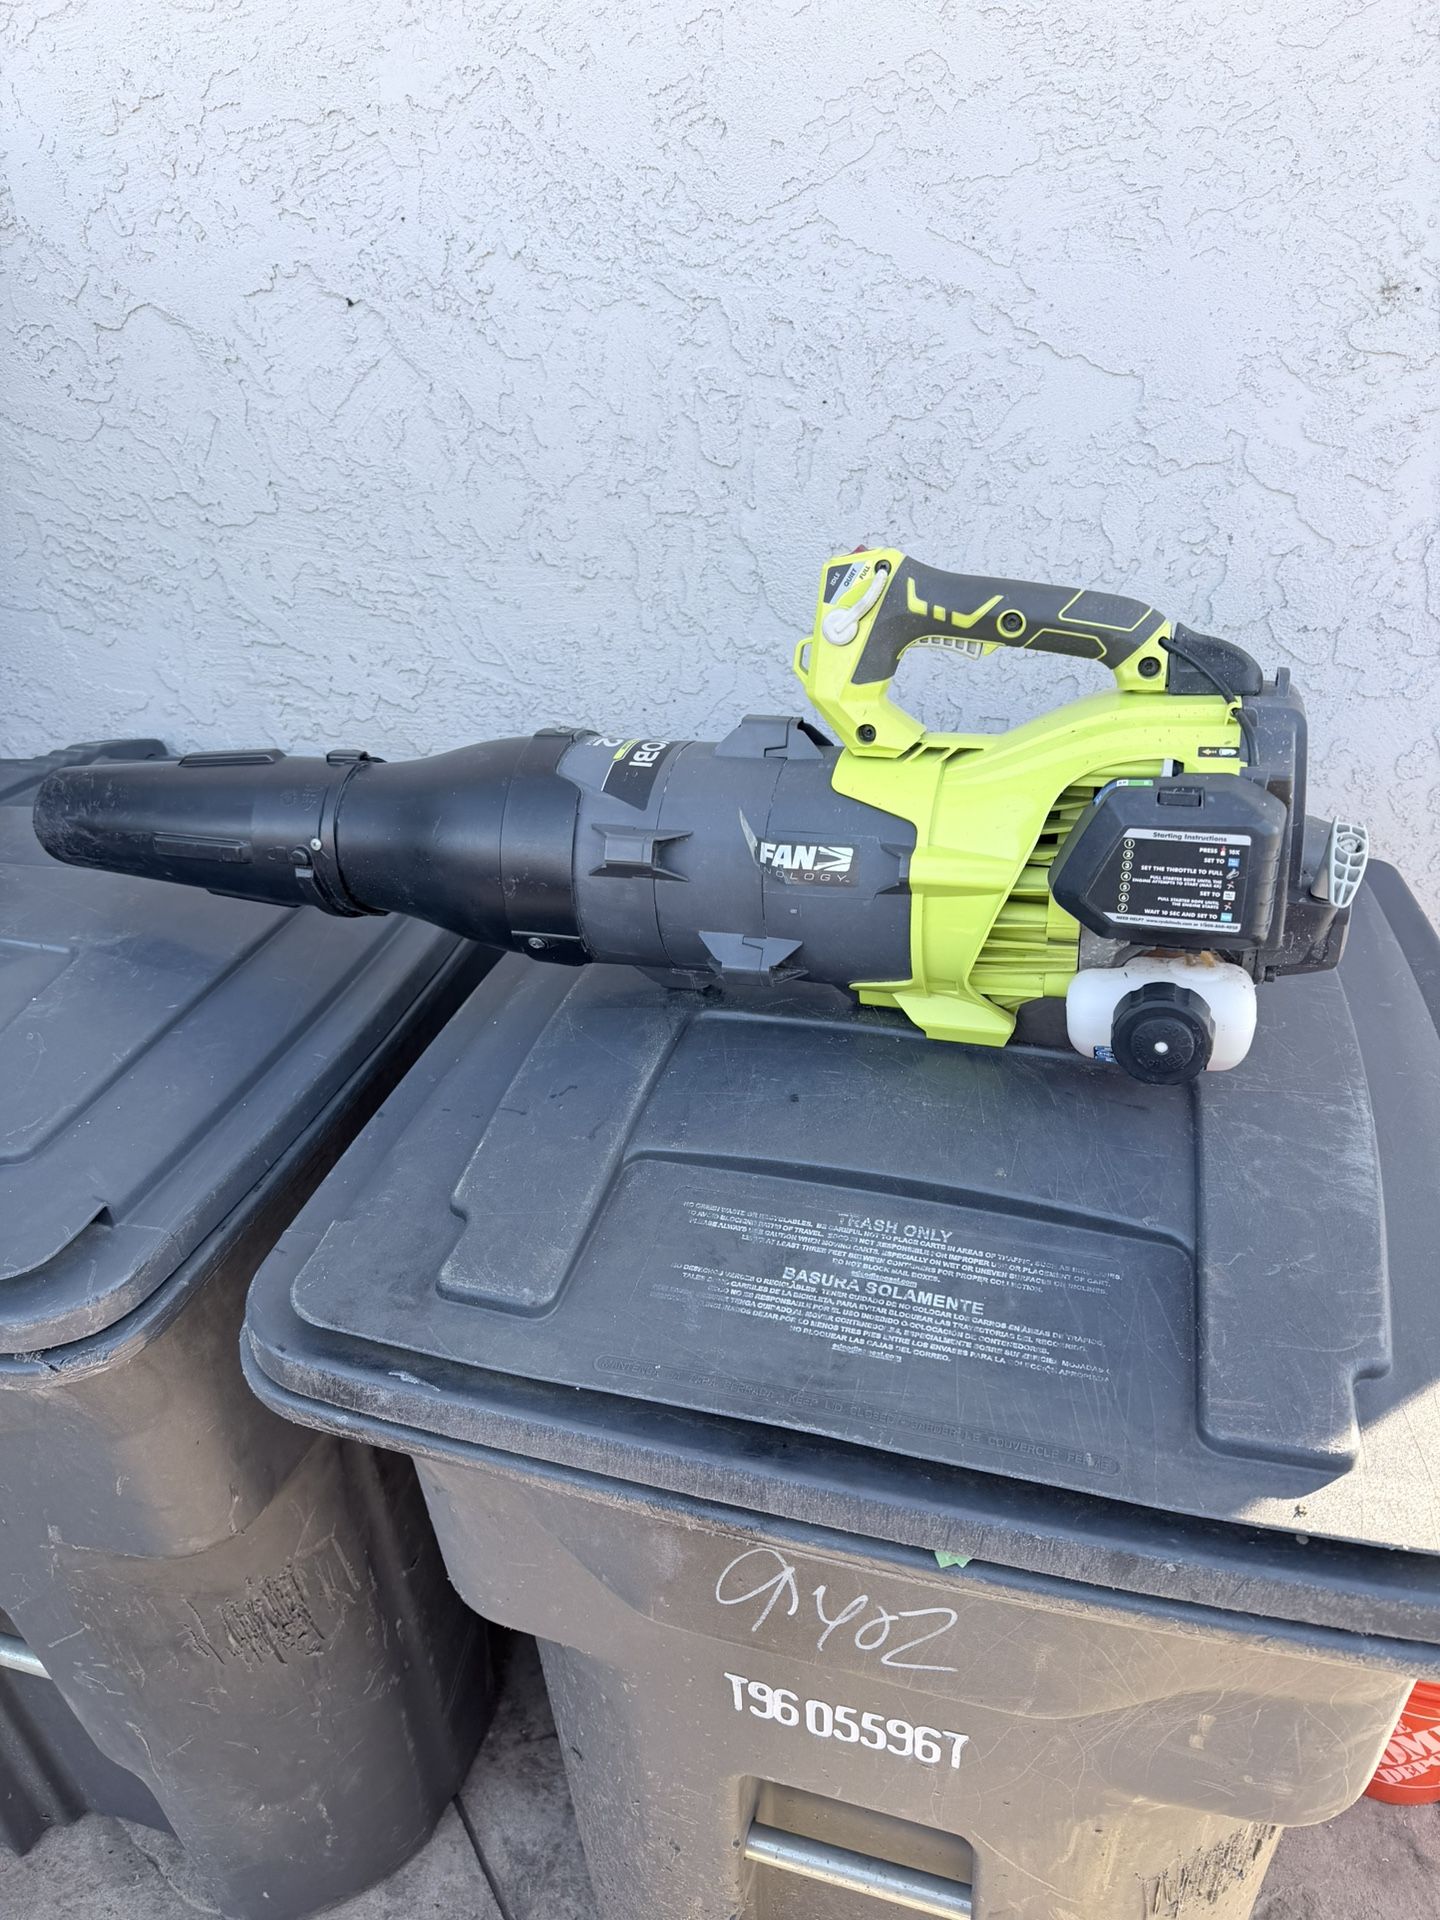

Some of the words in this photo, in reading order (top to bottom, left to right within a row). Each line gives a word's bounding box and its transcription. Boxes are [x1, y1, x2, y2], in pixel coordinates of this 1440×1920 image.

[844, 568, 857, 587] QUIET
[859, 566, 871, 580] FULL
[1153, 832, 1182, 840] Starting
[1184, 834, 1227, 842] Instructions
[760, 842, 817, 870] FAN
[903, 1223, 952, 1244] ONLY
[794, 1227, 823, 1238] TRAVEL.
[858, 1238, 874, 1246] NOT
[948, 1253, 989, 1266] IMPROPER
[1008, 1264, 1020, 1272] OR
[881, 1233, 891, 1241] TO
[892, 1235, 918, 1246] PLACE
[956, 1246, 983, 1257] AREAS
[798, 1236, 820, 1245] WHEN
[929, 1258, 940, 1266] ON
[942, 1261, 960, 1269] WET
[975, 1266, 1007, 1277] UNEVEN
[844, 1260, 862, 1268] NOT
[862, 1263, 889, 1273] BLOCK
[937, 1268, 953, 1277] FOR
[955, 1271, 988, 1283] PROPER
[782, 1265, 859, 1292] BASURA
[865, 1281, 984, 1315] SOLAMENTE
[836, 1300, 857, 1310] PARA
[858, 1304, 886, 1315] EVITAR
[848, 1293, 884, 1306] CUIDADO
[898, 1303, 910, 1311] NO
[912, 1305, 951, 1319] COLOCAR
[842, 1309, 859, 1319] USO
[900, 1320, 908, 1328] O
[841, 1326, 861, 1336] TRES
[911, 1339, 928, 1349] LOS
[970, 1350, 992, 1361] PARA
[994, 1355, 1005, 1363] LA
[848, 1336, 864, 1345] LAS
[866, 1339, 893, 1351] CAJAS
[723, 1672, 799, 1726] T96
[805, 1699, 970, 1769] 055967
